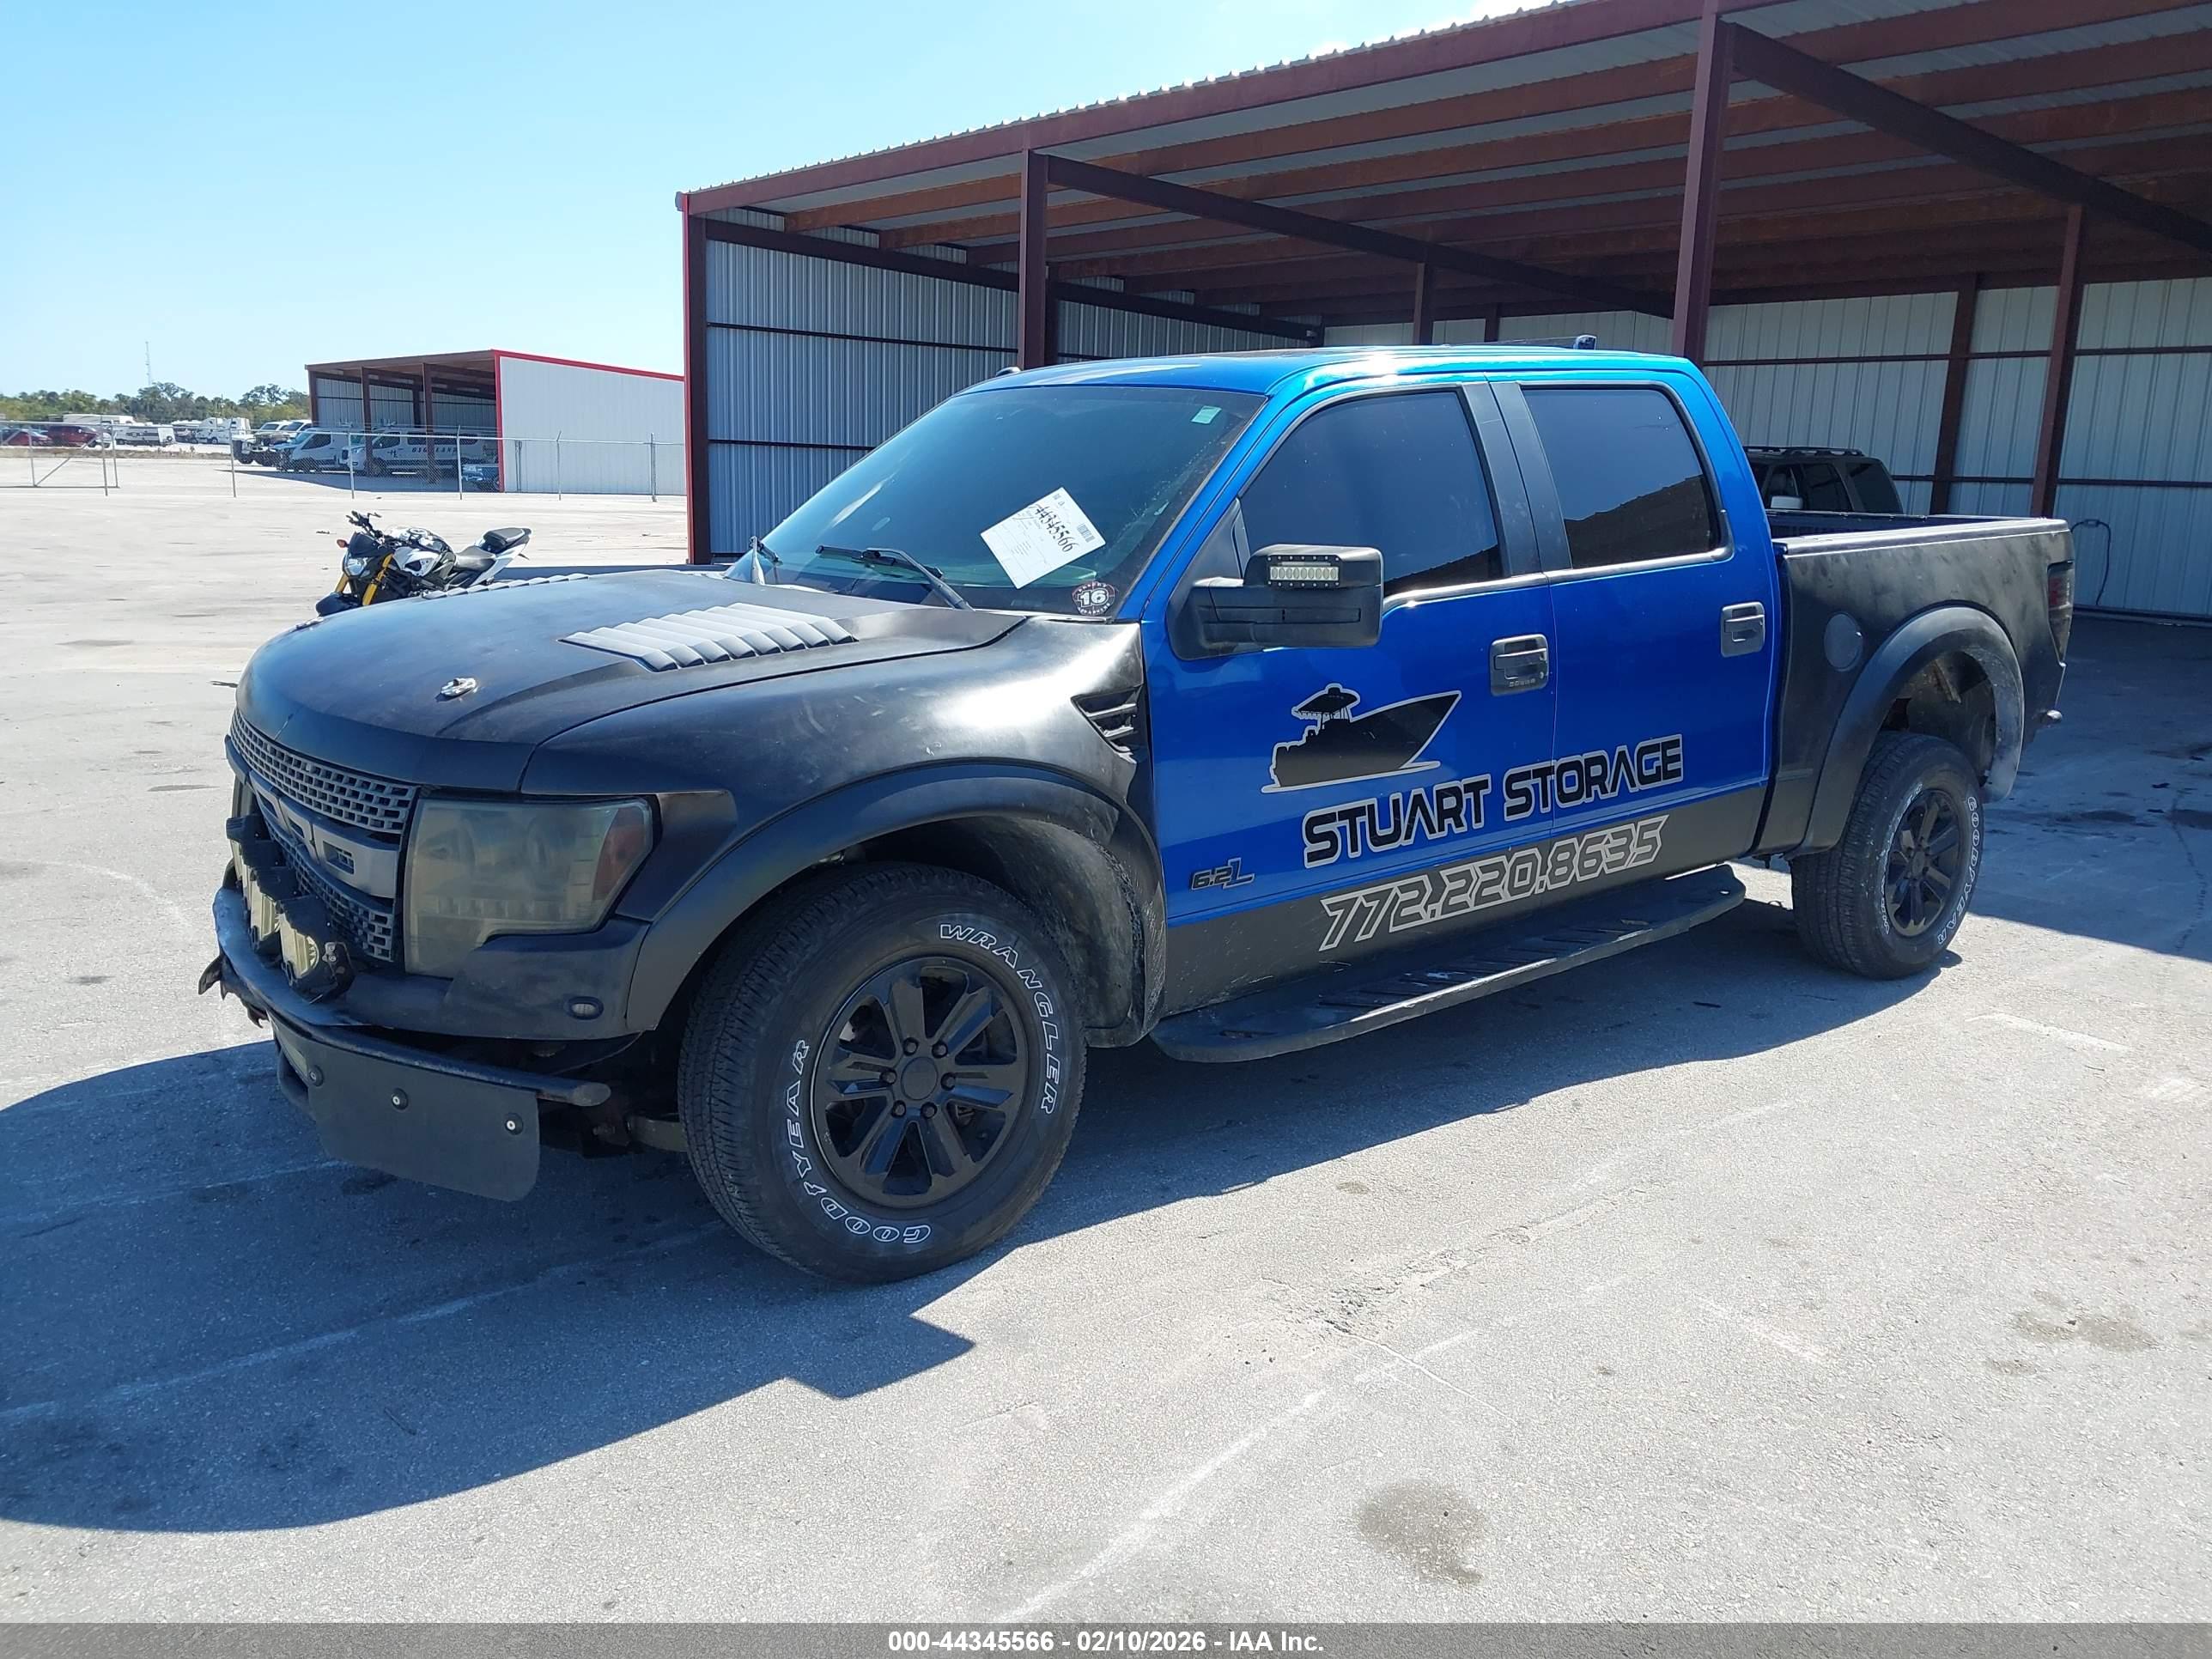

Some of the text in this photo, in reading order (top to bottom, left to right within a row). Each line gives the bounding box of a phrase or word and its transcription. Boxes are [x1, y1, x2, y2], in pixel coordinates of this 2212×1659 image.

[1035, 505, 1079, 552] 44345566
[1078, 587, 1109, 607] 16
[1302, 733, 1684, 869] STUART STORAGE
[1191, 857, 1255, 890] 6.2L
[1318, 814, 1670, 952] 772.220.8635
[939, 923, 1061, 1115] WRANGLER
[785, 1038, 932, 1244] GOODYEAR
